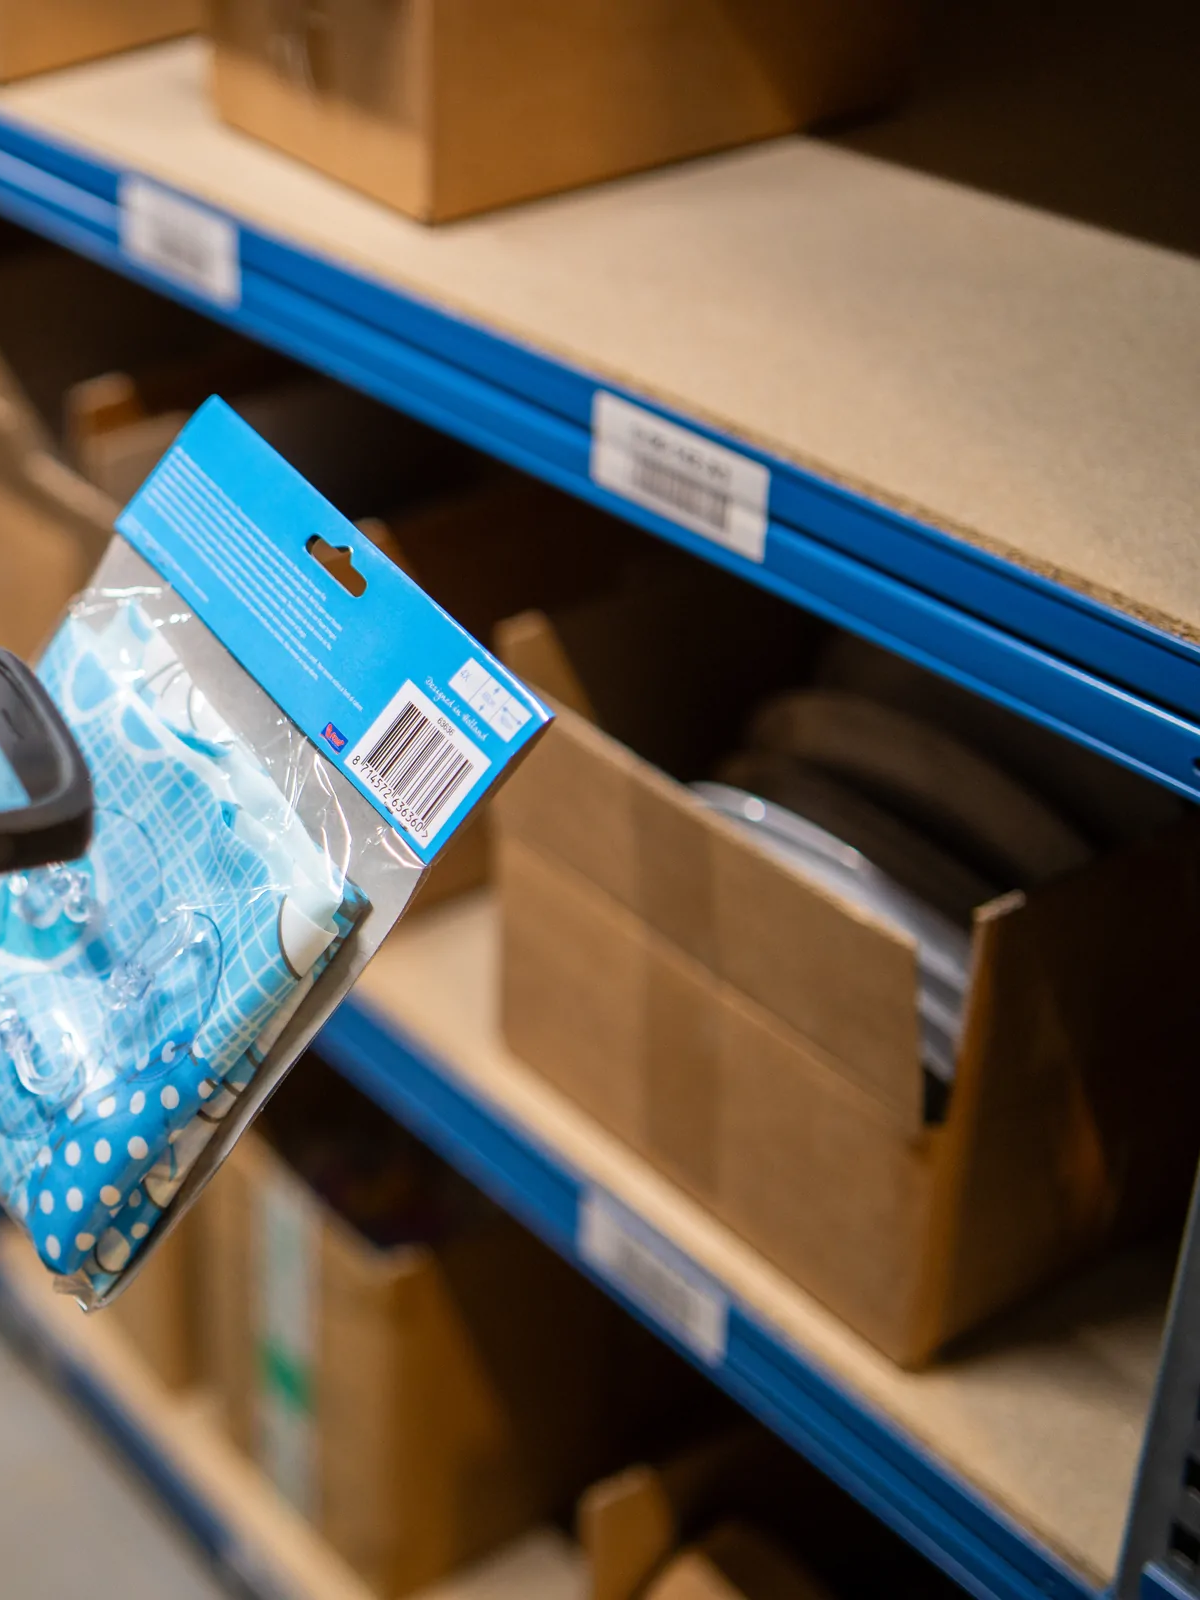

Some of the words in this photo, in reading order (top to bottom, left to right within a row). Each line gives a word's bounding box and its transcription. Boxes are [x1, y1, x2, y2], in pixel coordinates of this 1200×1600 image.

[425, 675, 455, 708] Designed
[452, 704, 461, 717] in
[462, 713, 489, 742] Holland
[437, 717, 455, 736] 63636
[352, 755, 361, 766] 8
